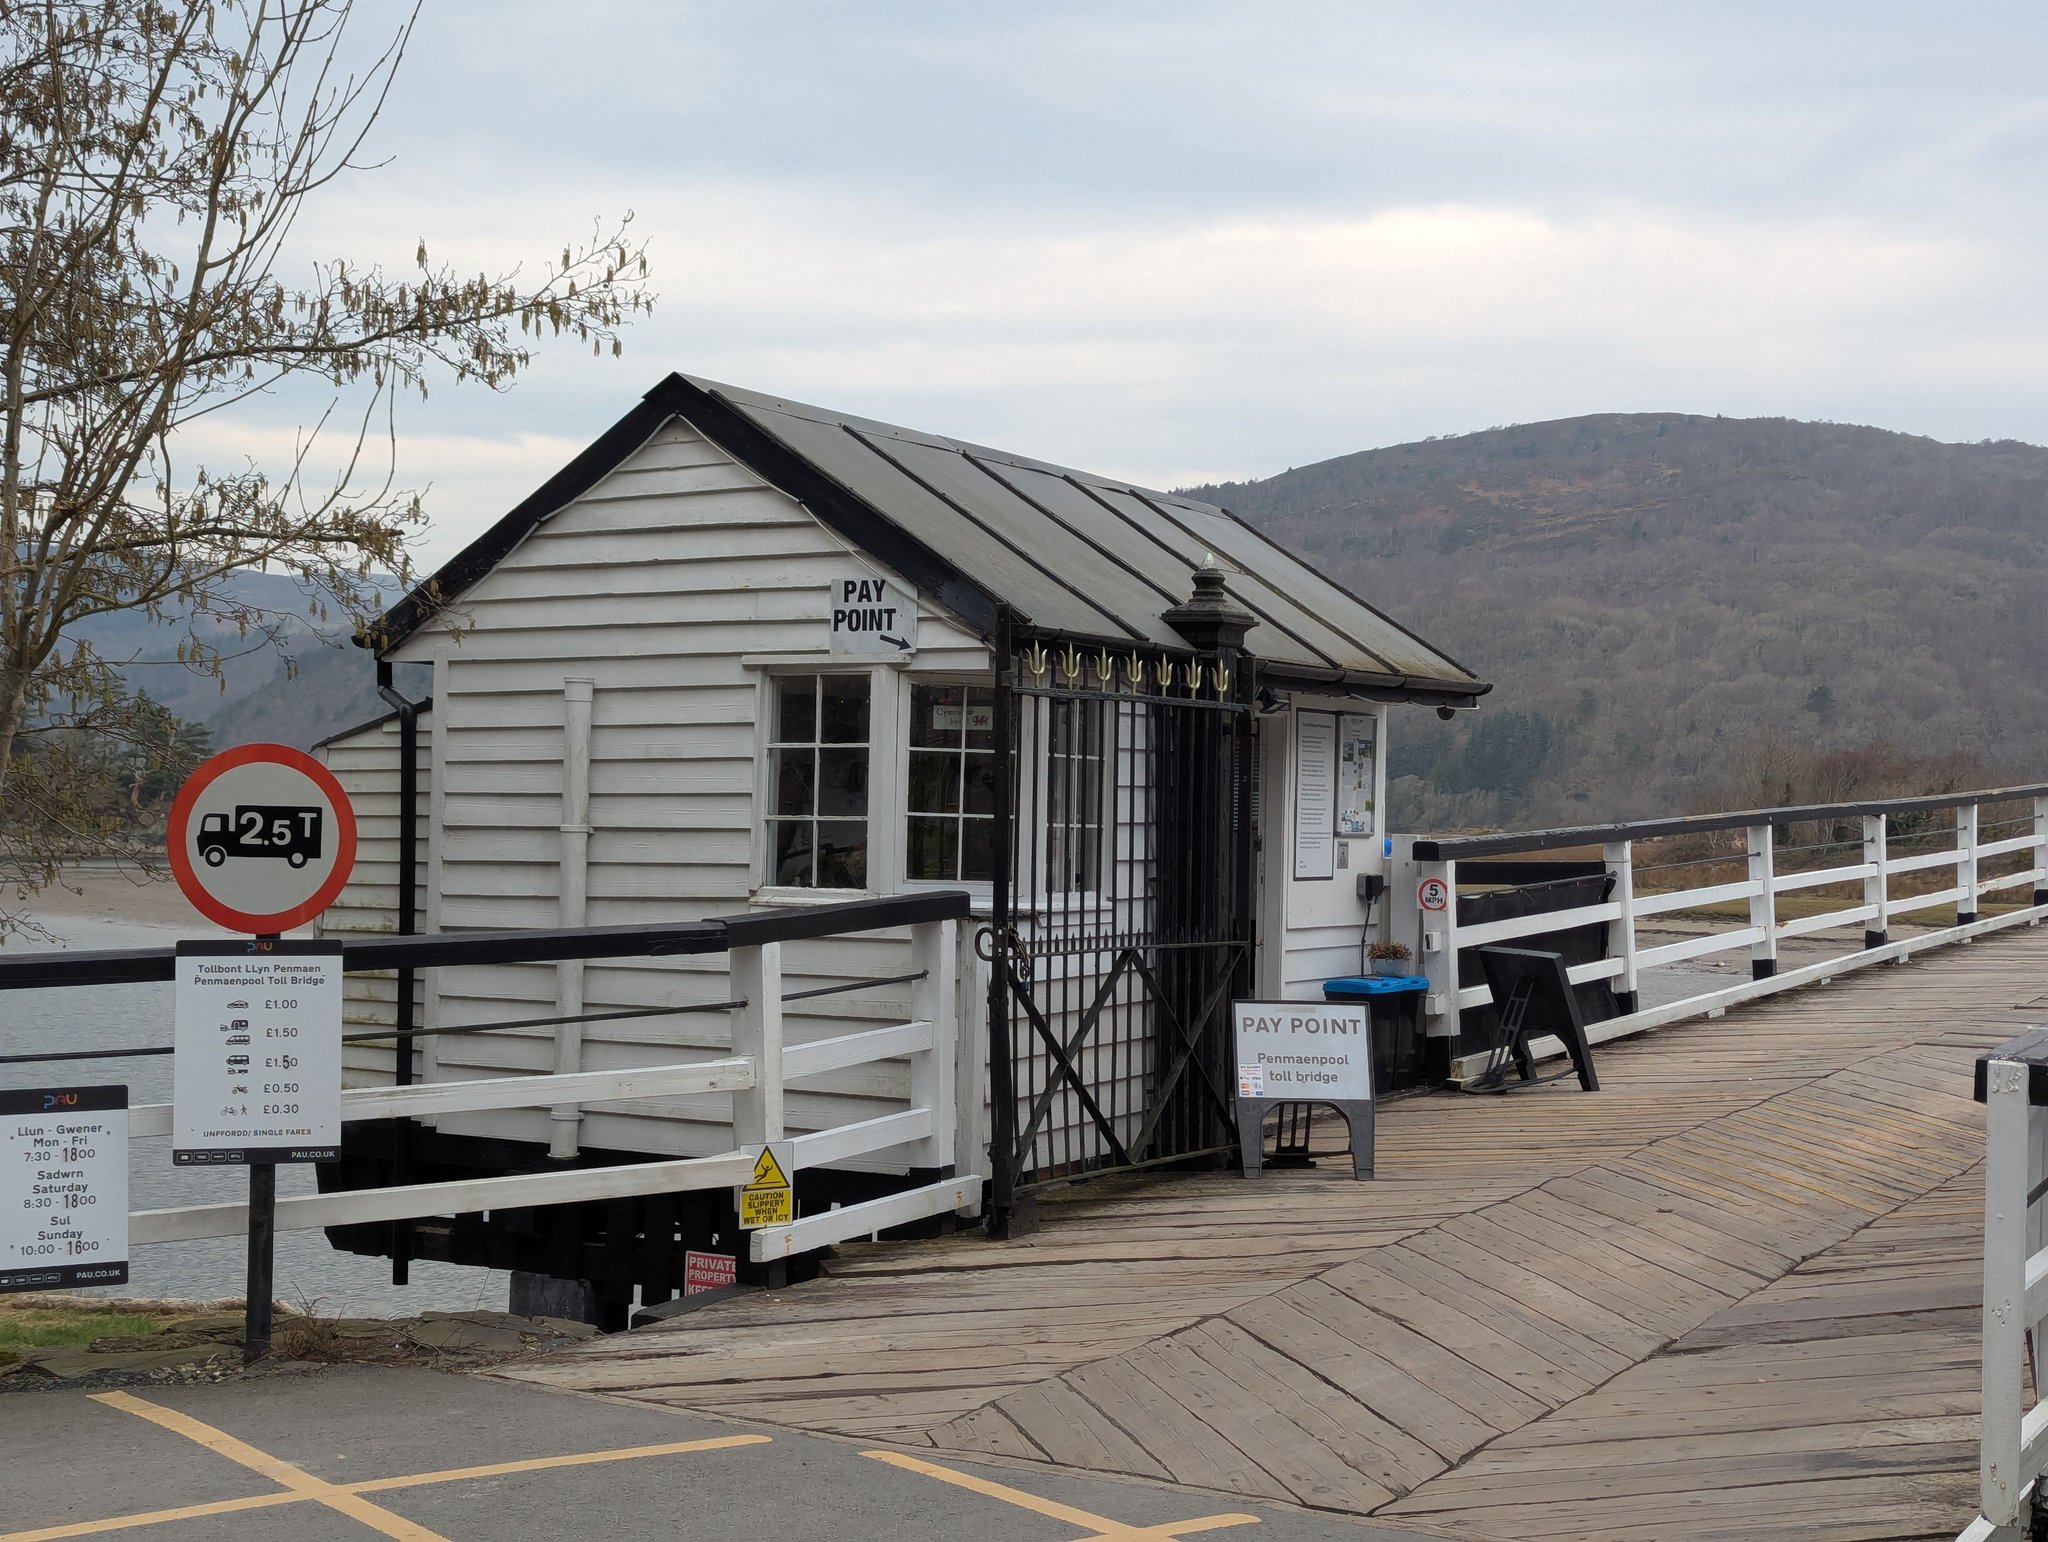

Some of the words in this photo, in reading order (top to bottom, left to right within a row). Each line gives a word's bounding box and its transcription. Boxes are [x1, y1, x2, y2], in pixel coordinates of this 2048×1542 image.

[844, 579, 886, 603] PAY
[833, 608, 896, 632] POINT
[240, 811, 291, 846] 2.5
[298, 812, 317, 838] T
[1429, 884, 1438, 896] 5
[1425, 896, 1443, 904] MPH
[198, 964, 242, 973] Tollbont
[274, 964, 321, 973] Penmaen
[194, 976, 264, 987] Penmaenpool
[268, 976, 288, 985] Toll
[291, 976, 325, 987] Bridge
[265, 999, 298, 1009] £1.00
[1242, 1017, 1282, 1033] PAY
[1291, 1017, 1361, 1035] POINT
[266, 1028, 298, 1038] £1.50
[265, 1055, 298, 1069] £1.50
[1257, 1053, 1349, 1066] Penmaenpool
[1269, 1070, 1292, 1082] toll
[1296, 1071, 1338, 1084] bridge
[264, 1083, 299, 1093] £0.50
[263, 1105, 299, 1114] £0.30
[18, 1127, 44, 1137] Llun
[56, 1124, 103, 1135] Gwener
[253, 1129, 283, 1137] SINGLE
[285, 1128, 311, 1136] FARES
[33, 1137, 59, 1148] Mon
[72, 1136, 88, 1146] Fri
[24, 1152, 51, 1162] 7:30
[62, 1147, 95, 1162] 1800
[291, 1151, 335, 1159] PAU.CO.UK
[37, 1170, 84, 1180] Sadwrn
[32, 1183, 88, 1194] Saturday
[23, 1198, 52, 1209] 8:30
[64, 1194, 97, 1209] 1800
[749, 1191, 784, 1201] CAUTION
[748, 1199, 785, 1209] SLIPPERY
[755, 1207, 778, 1216] WHEN
[50, 1216, 71, 1226] Sul
[743, 1216, 760, 1224] WET
[763, 1215, 773, 1223] OR
[776, 1213, 789, 1222] ICY
[37, 1230, 83, 1241] Sunday
[20, 1245, 54, 1256] 10:00
[67, 1241, 99, 1255] 1600
[76, 1269, 120, 1279] PAU.CO.UK
